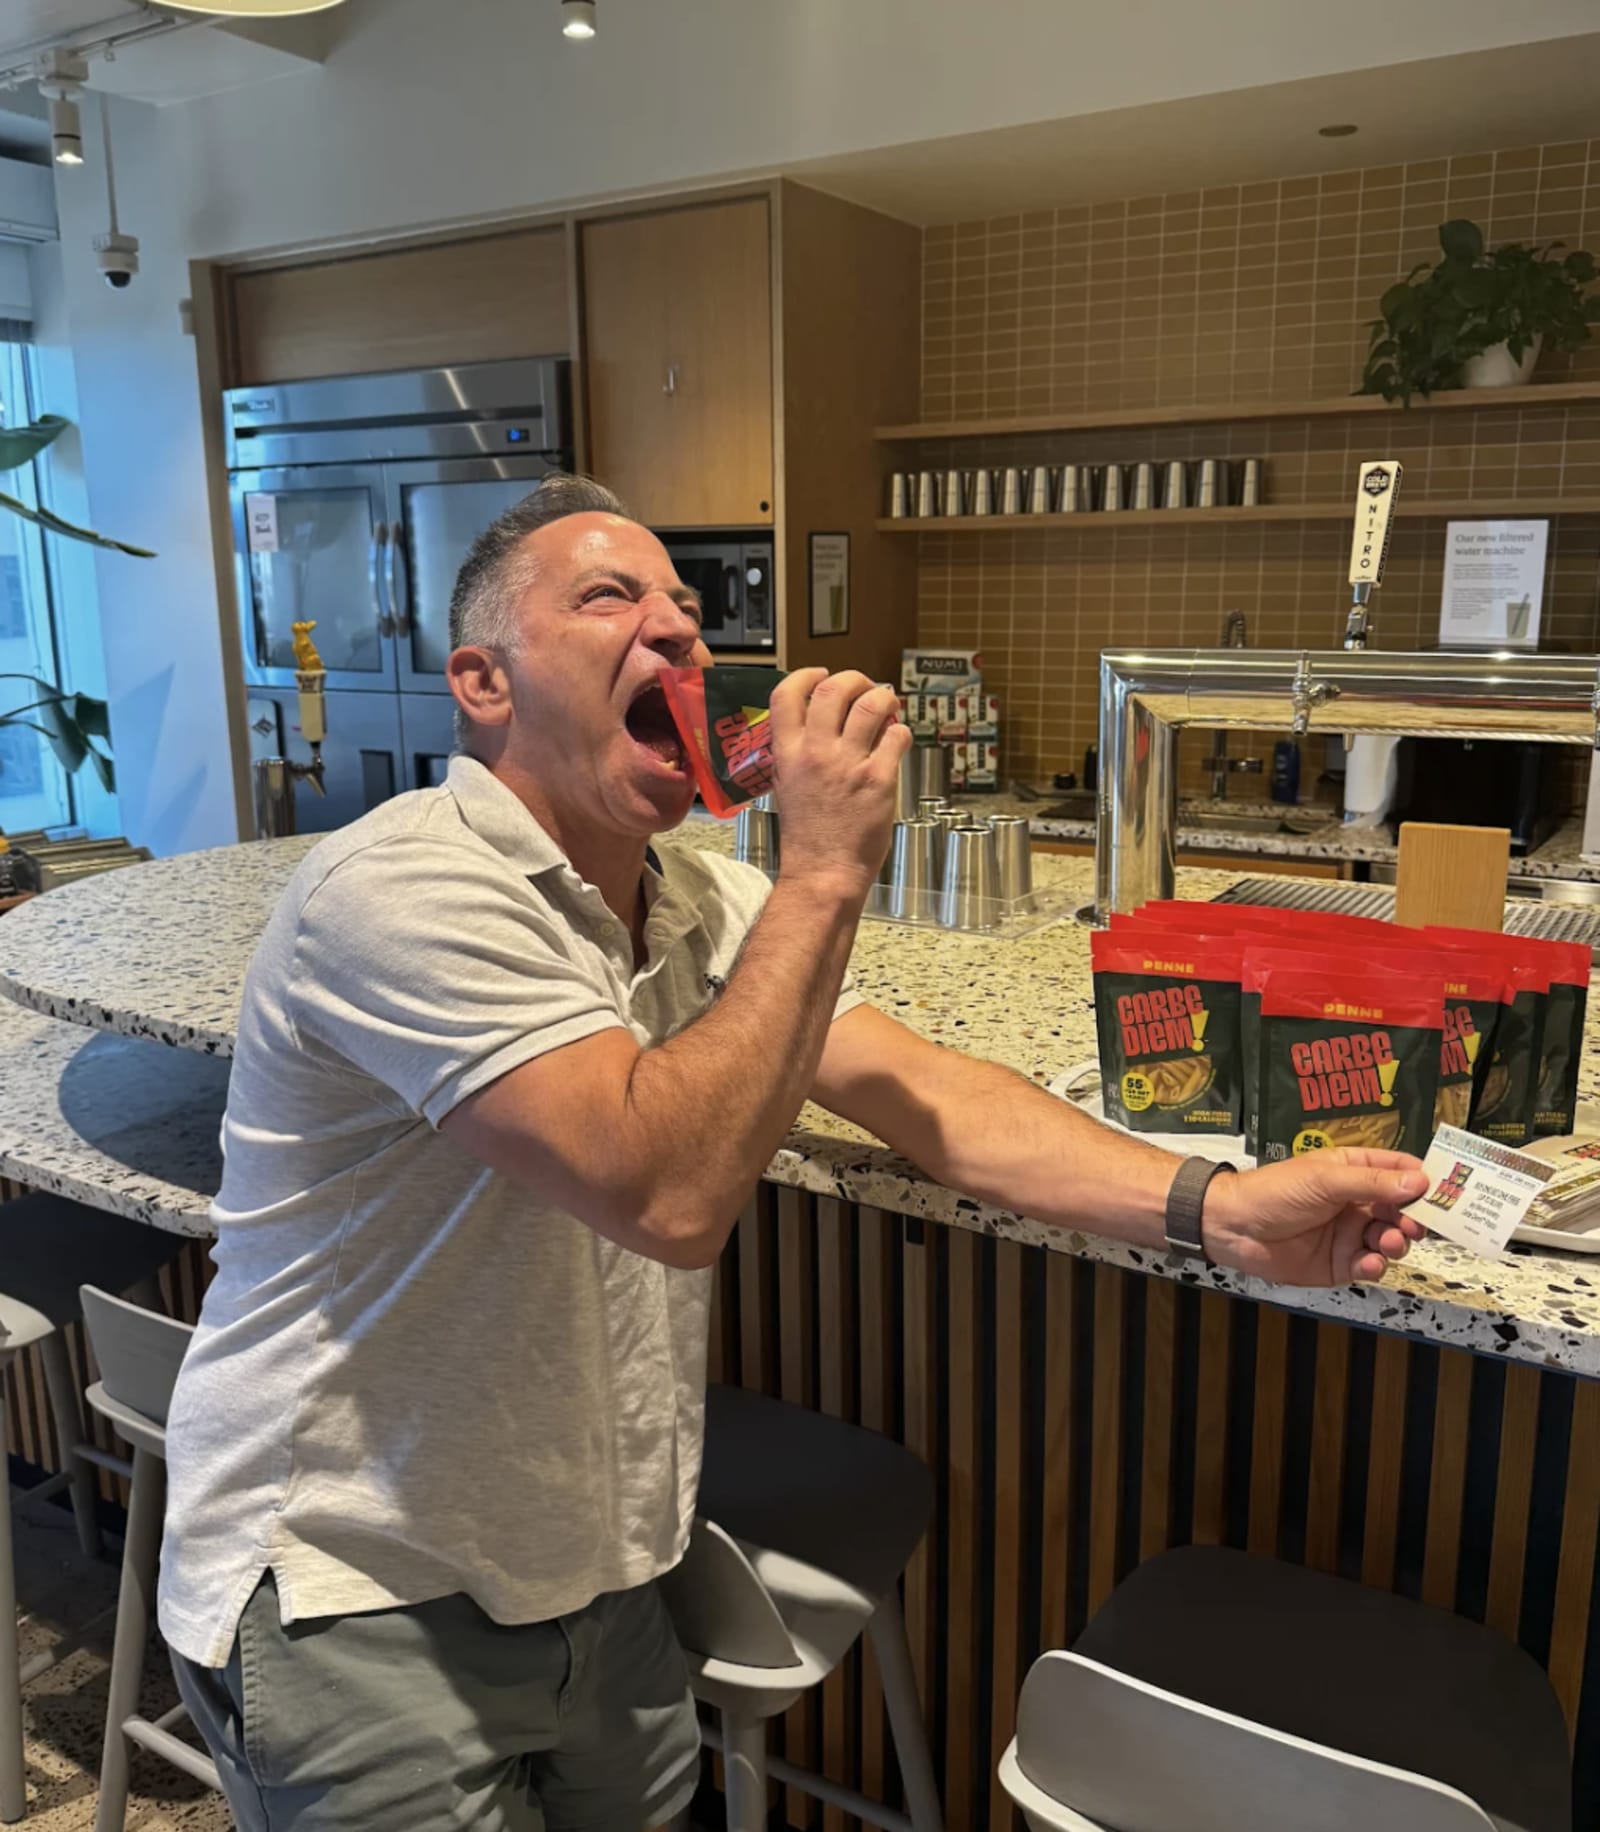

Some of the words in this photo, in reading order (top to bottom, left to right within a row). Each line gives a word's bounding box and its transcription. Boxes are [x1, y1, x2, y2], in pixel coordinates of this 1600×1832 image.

[1360, 504, 1377, 568] NITRO
[1455, 534, 1475, 543] Our
[1455, 547, 1482, 555] water
[1483, 545, 1526, 555] machine
[920, 658, 963, 669] NUMI
[1143, 960, 1195, 974] PENNE
[1323, 1003, 1383, 1019] PENNE
